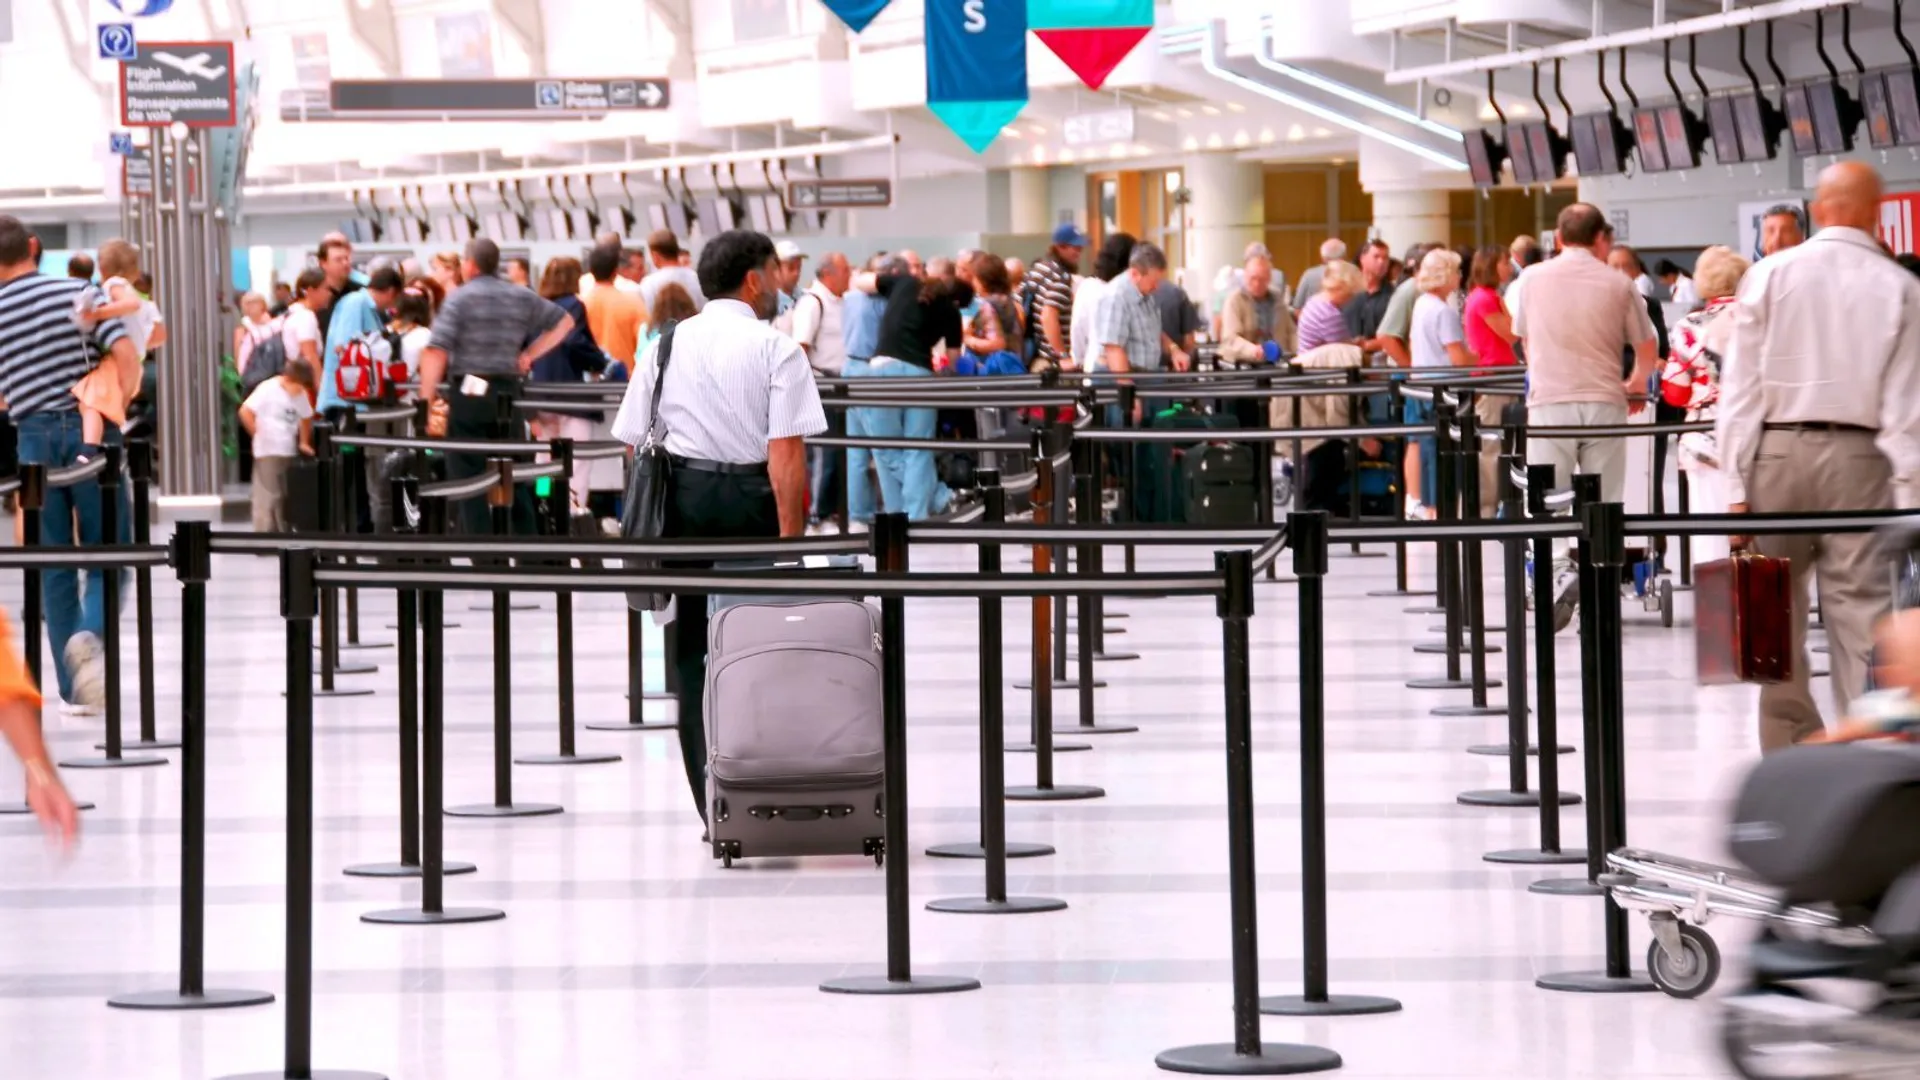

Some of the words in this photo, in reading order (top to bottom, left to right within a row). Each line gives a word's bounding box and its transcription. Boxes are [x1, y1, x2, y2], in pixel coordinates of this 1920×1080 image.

[963, 0, 986, 33] S
[126, 67, 162, 81] Flight
[126, 79, 197, 92] Information
[127, 97, 229, 112] Renseignements
[127, 111, 144, 121] de
[145, 110, 172, 121] vols
